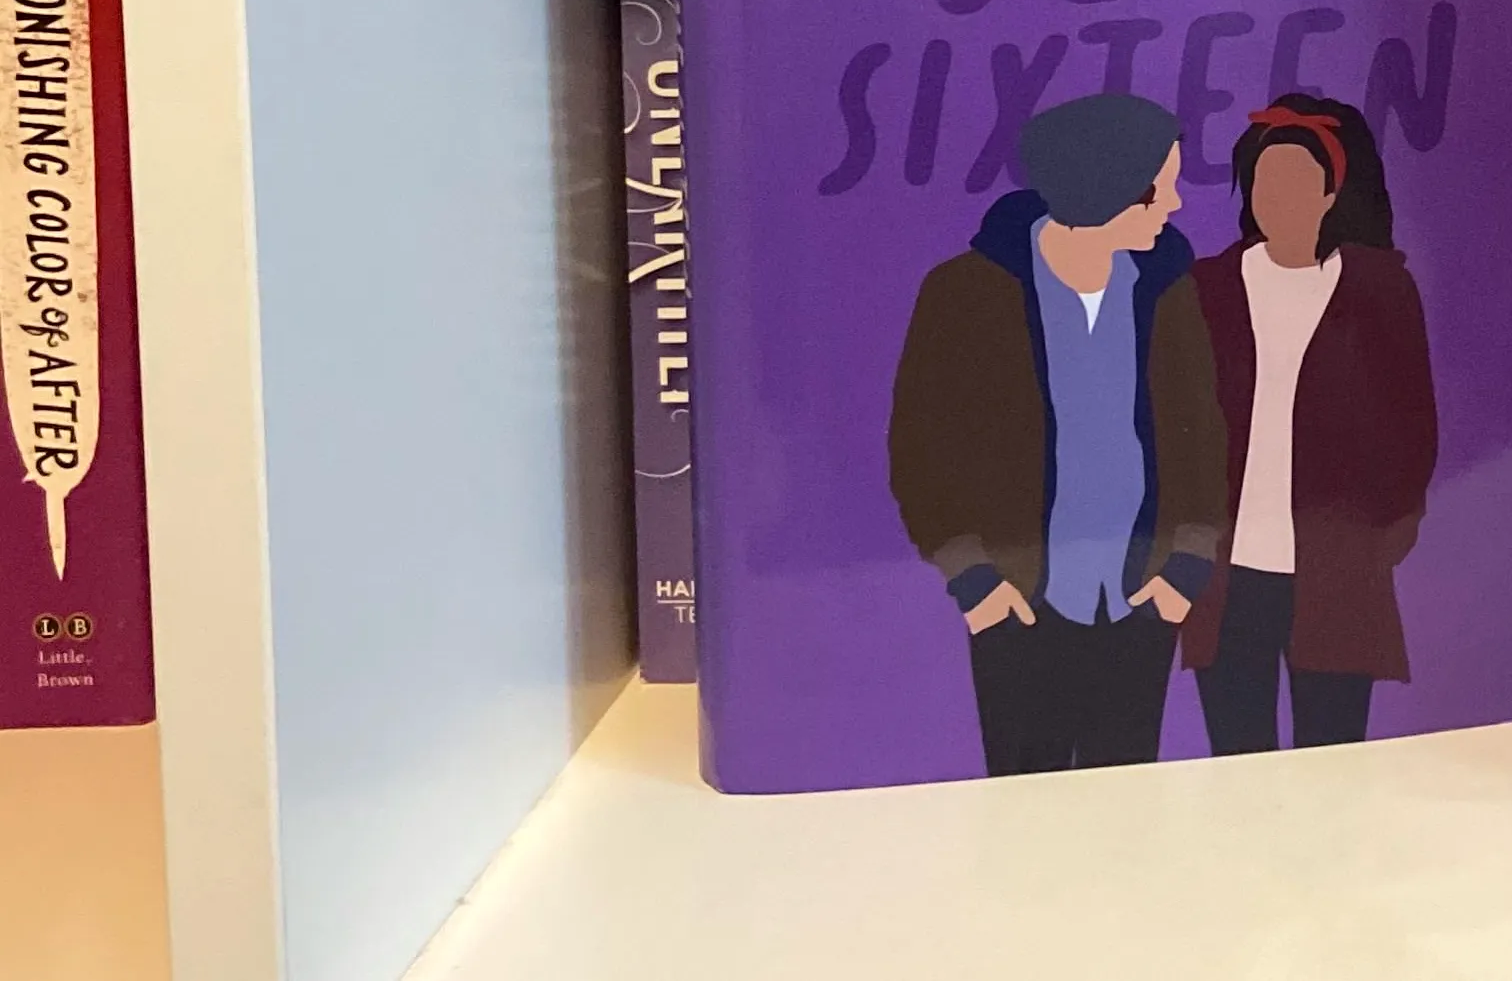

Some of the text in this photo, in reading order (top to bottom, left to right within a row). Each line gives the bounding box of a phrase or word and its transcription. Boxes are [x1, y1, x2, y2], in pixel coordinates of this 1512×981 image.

[817, 0, 1458, 198] SIXTEEN
[26, 189, 73, 303] COLOR
[19, 307, 70, 348] of
[28, 349, 81, 477] AFTER
[37, 672, 94, 688] Brown
